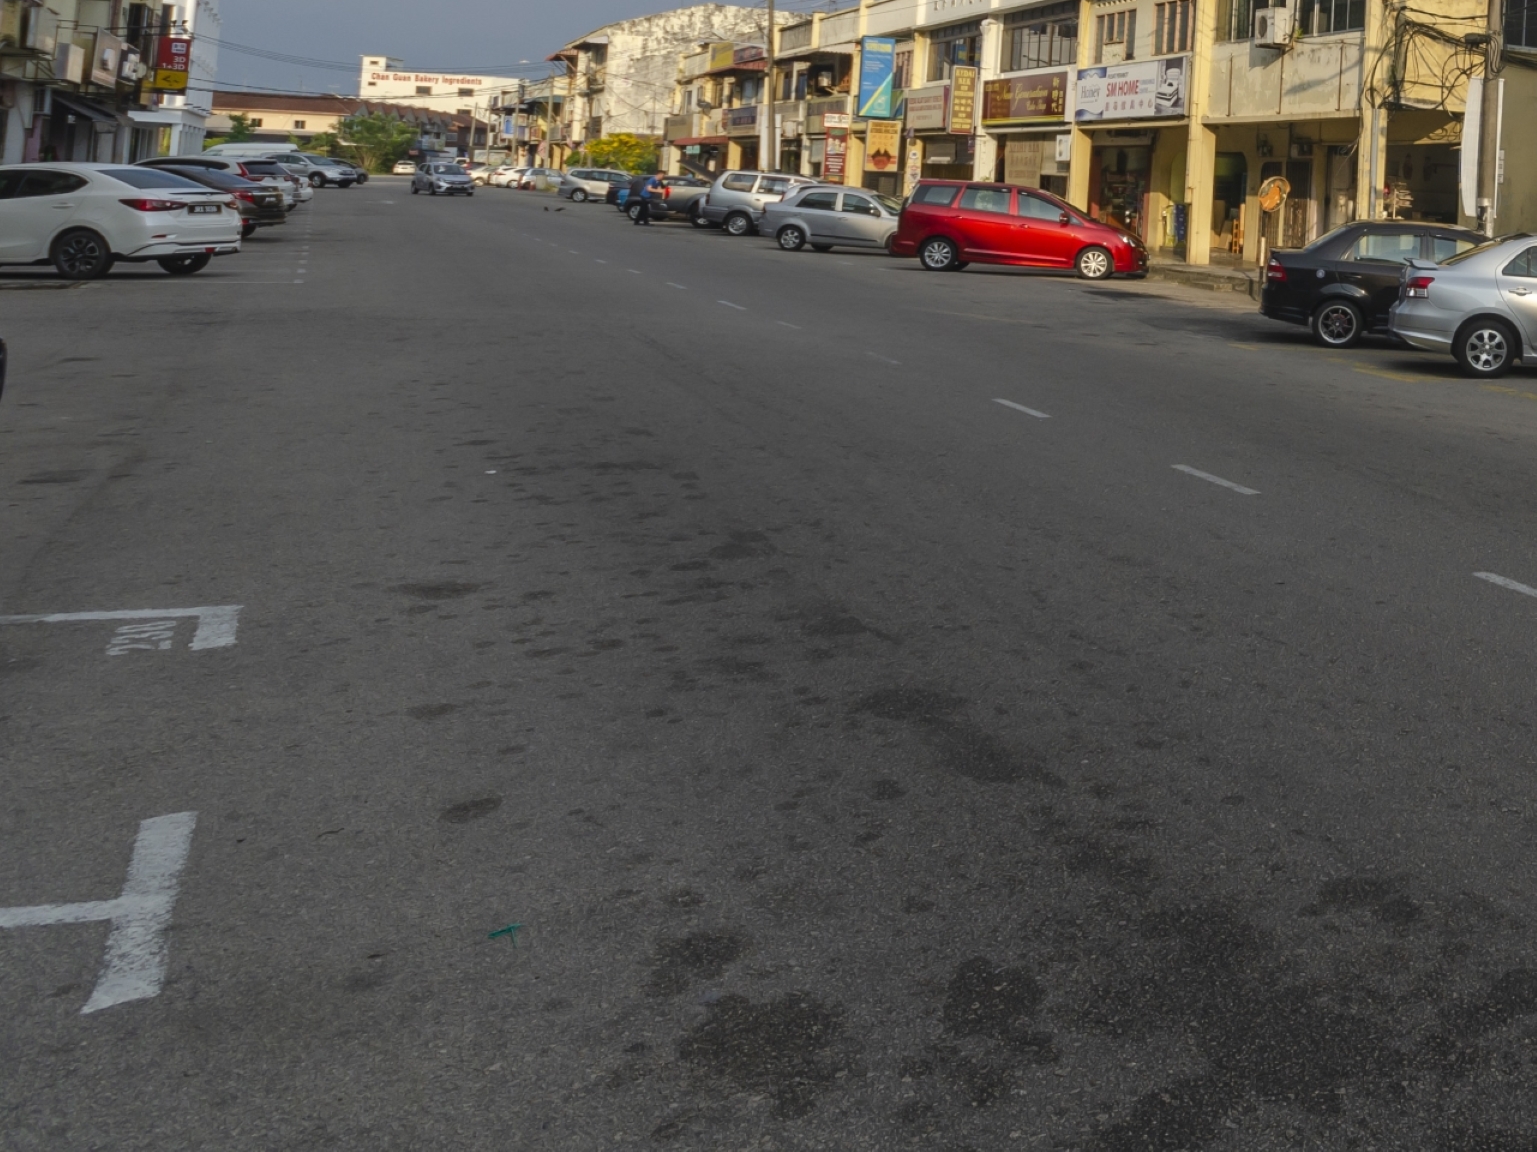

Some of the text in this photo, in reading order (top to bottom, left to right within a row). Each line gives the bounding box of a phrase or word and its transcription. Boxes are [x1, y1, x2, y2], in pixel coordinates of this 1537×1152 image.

[371, 72, 389, 81] Chan
[415, 74, 439, 84] Bakery
[442, 75, 482, 86] Ingredients
[1106, 82, 1117, 97] SM
[1118, 79, 1139, 97] HOME
